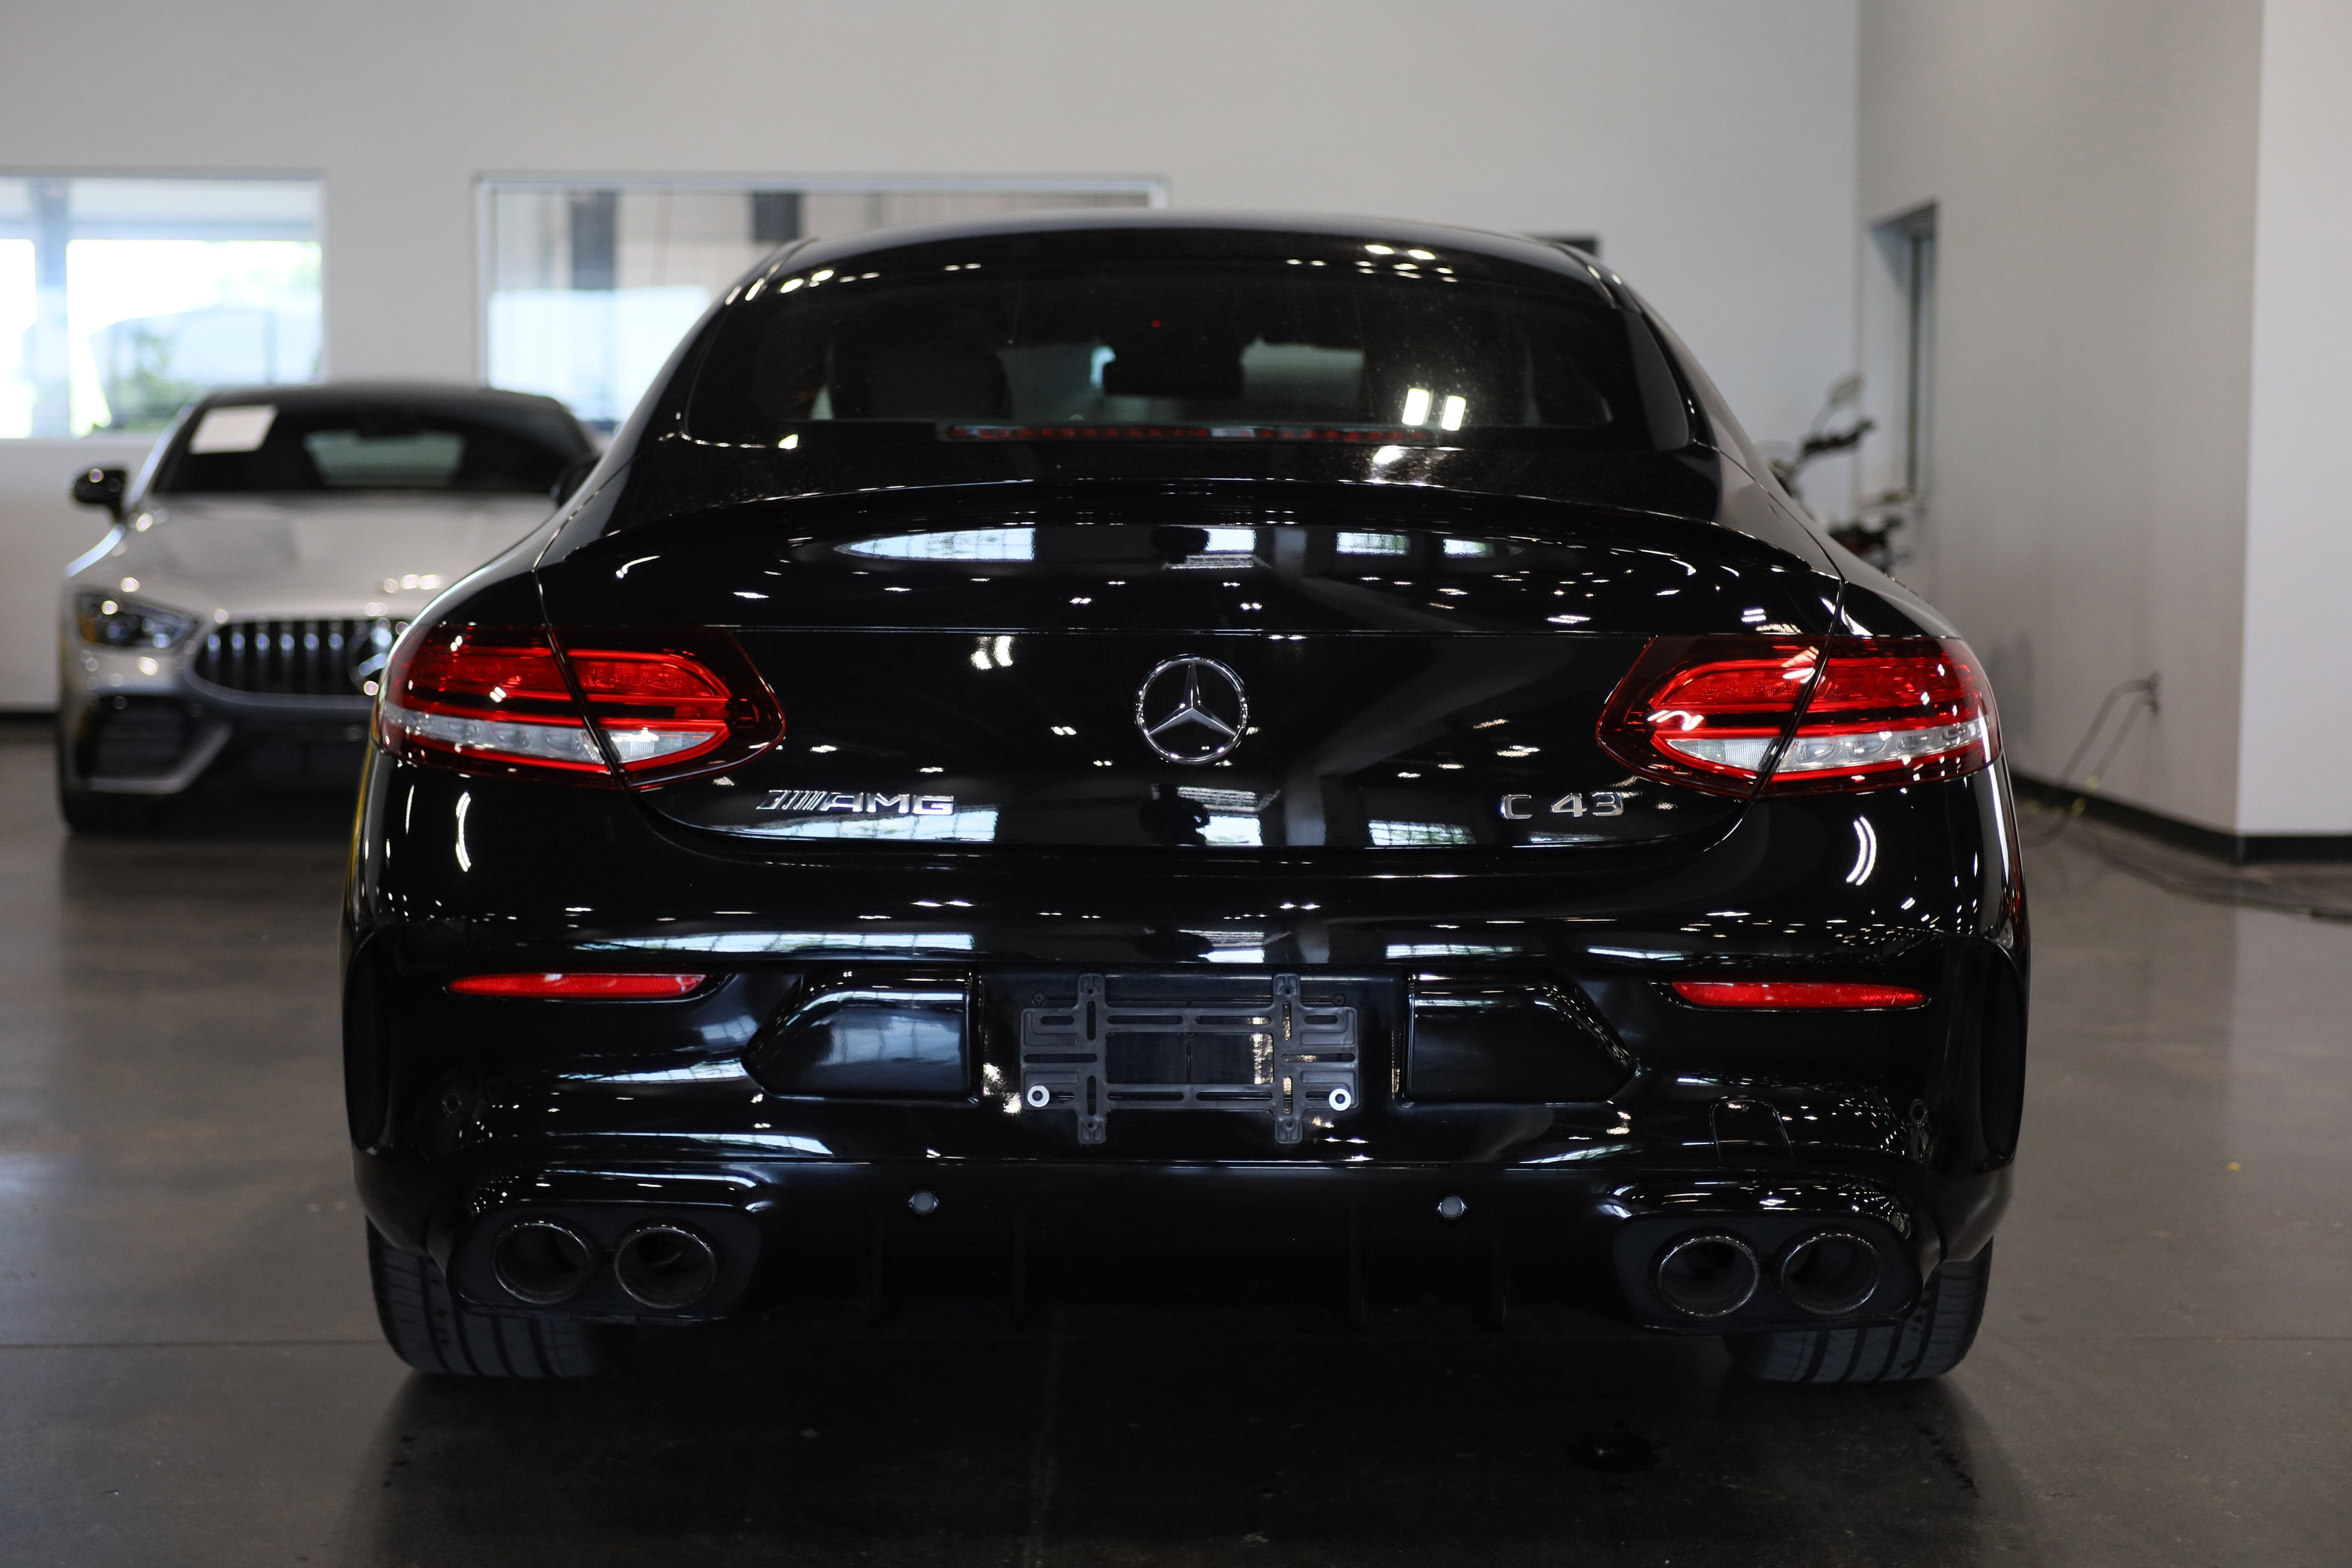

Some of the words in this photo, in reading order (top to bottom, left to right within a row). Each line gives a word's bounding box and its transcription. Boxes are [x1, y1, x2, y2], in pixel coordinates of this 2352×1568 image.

[820, 791, 954, 815] AMG
[1501, 793, 1532, 820] C
[1550, 792, 1624, 817] 43
